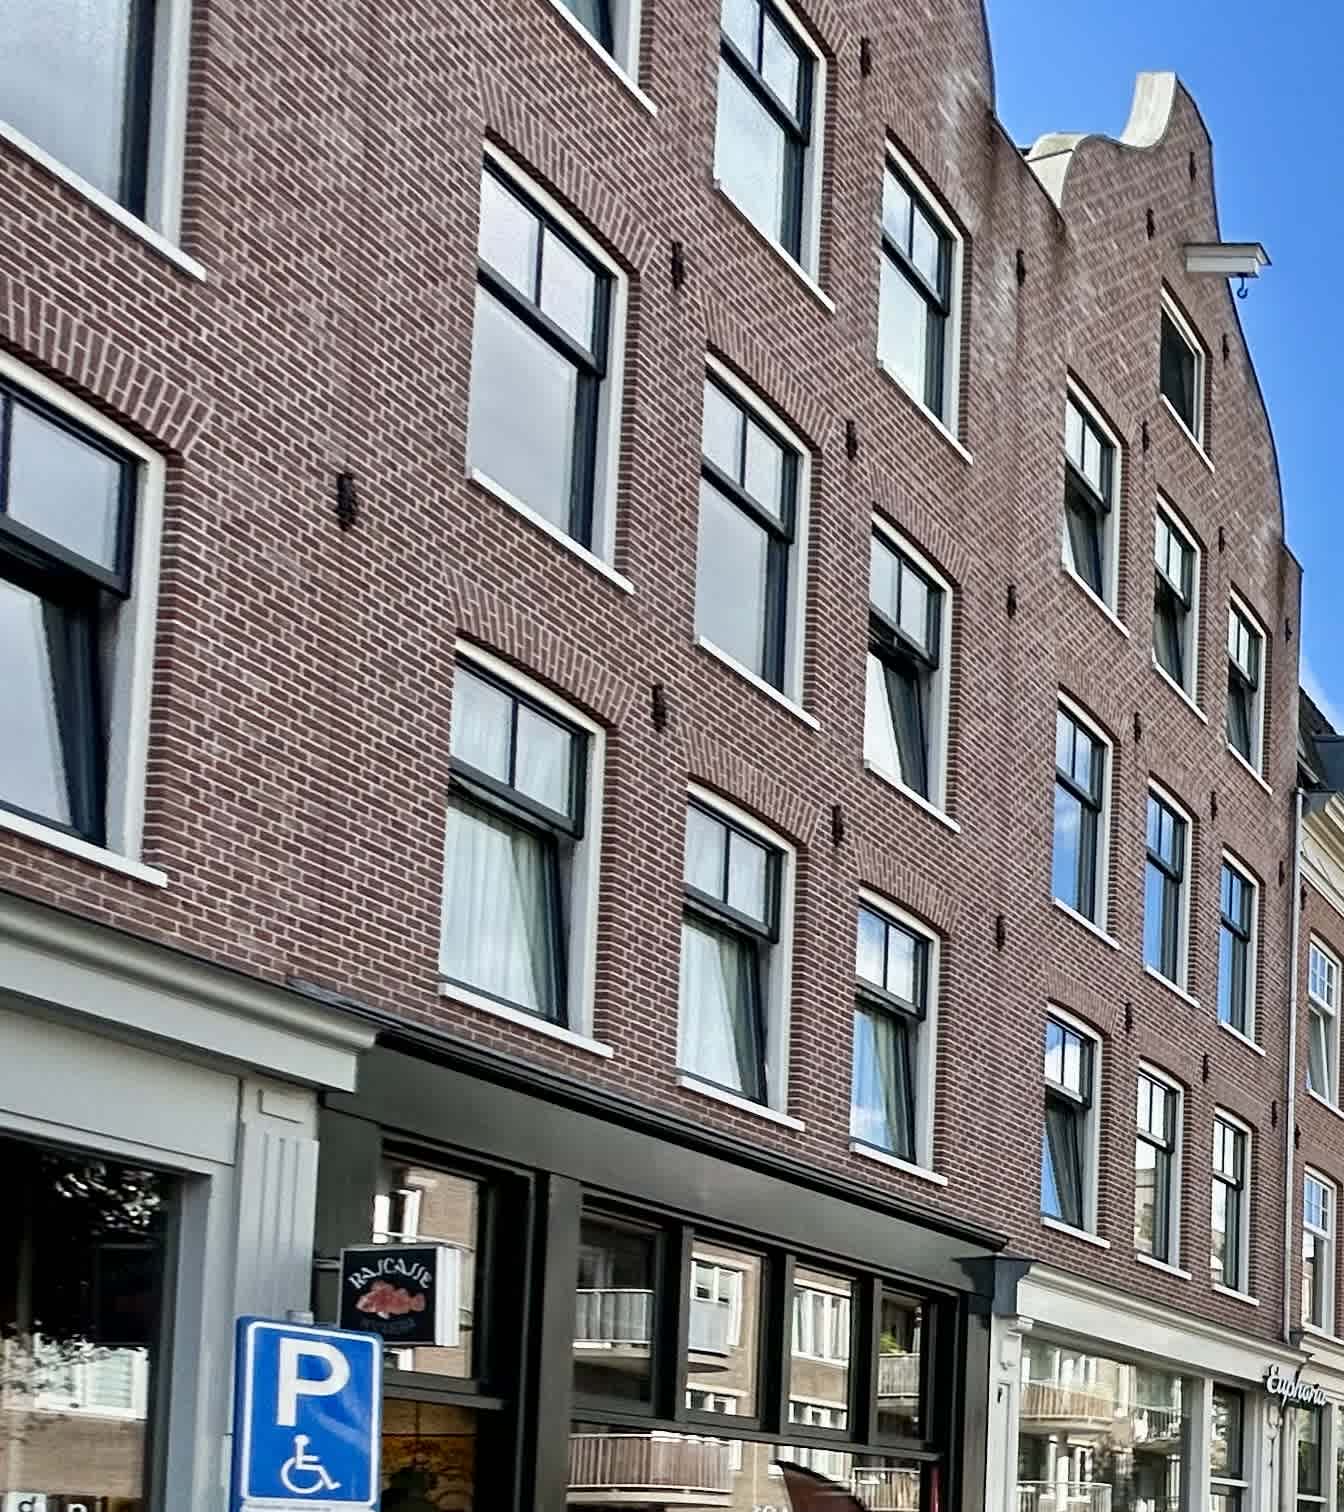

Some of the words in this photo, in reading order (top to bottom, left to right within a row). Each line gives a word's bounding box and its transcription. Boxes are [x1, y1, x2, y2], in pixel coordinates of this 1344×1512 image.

[348, 1257, 433, 1289] RASCASSE
[277, 1338, 350, 1427] P
[1266, 1363, 1329, 1407] Euphoria
